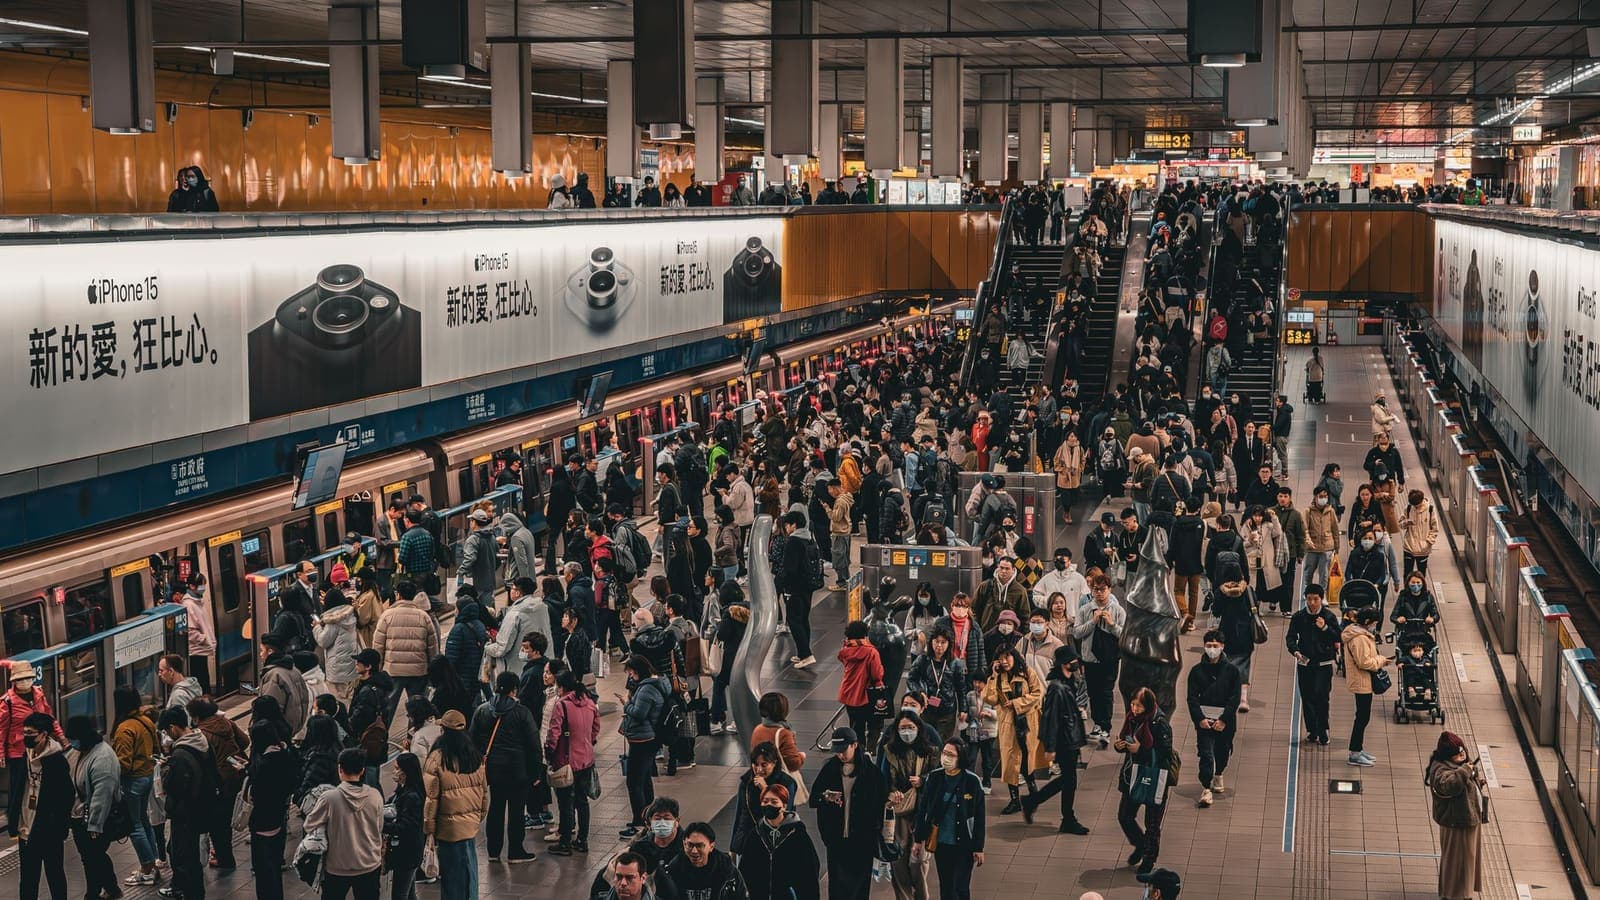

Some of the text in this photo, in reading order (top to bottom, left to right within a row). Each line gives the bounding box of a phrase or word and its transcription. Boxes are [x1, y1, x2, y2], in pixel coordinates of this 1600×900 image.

[1172, 135, 1181, 148] 3
[479, 252, 509, 271] iPhone 15
[98, 276, 158, 304] iPhone 15
[178, 456, 205, 479] 市政府
[182, 613, 187, 626] 3
[36, 667, 43, 681] 3
